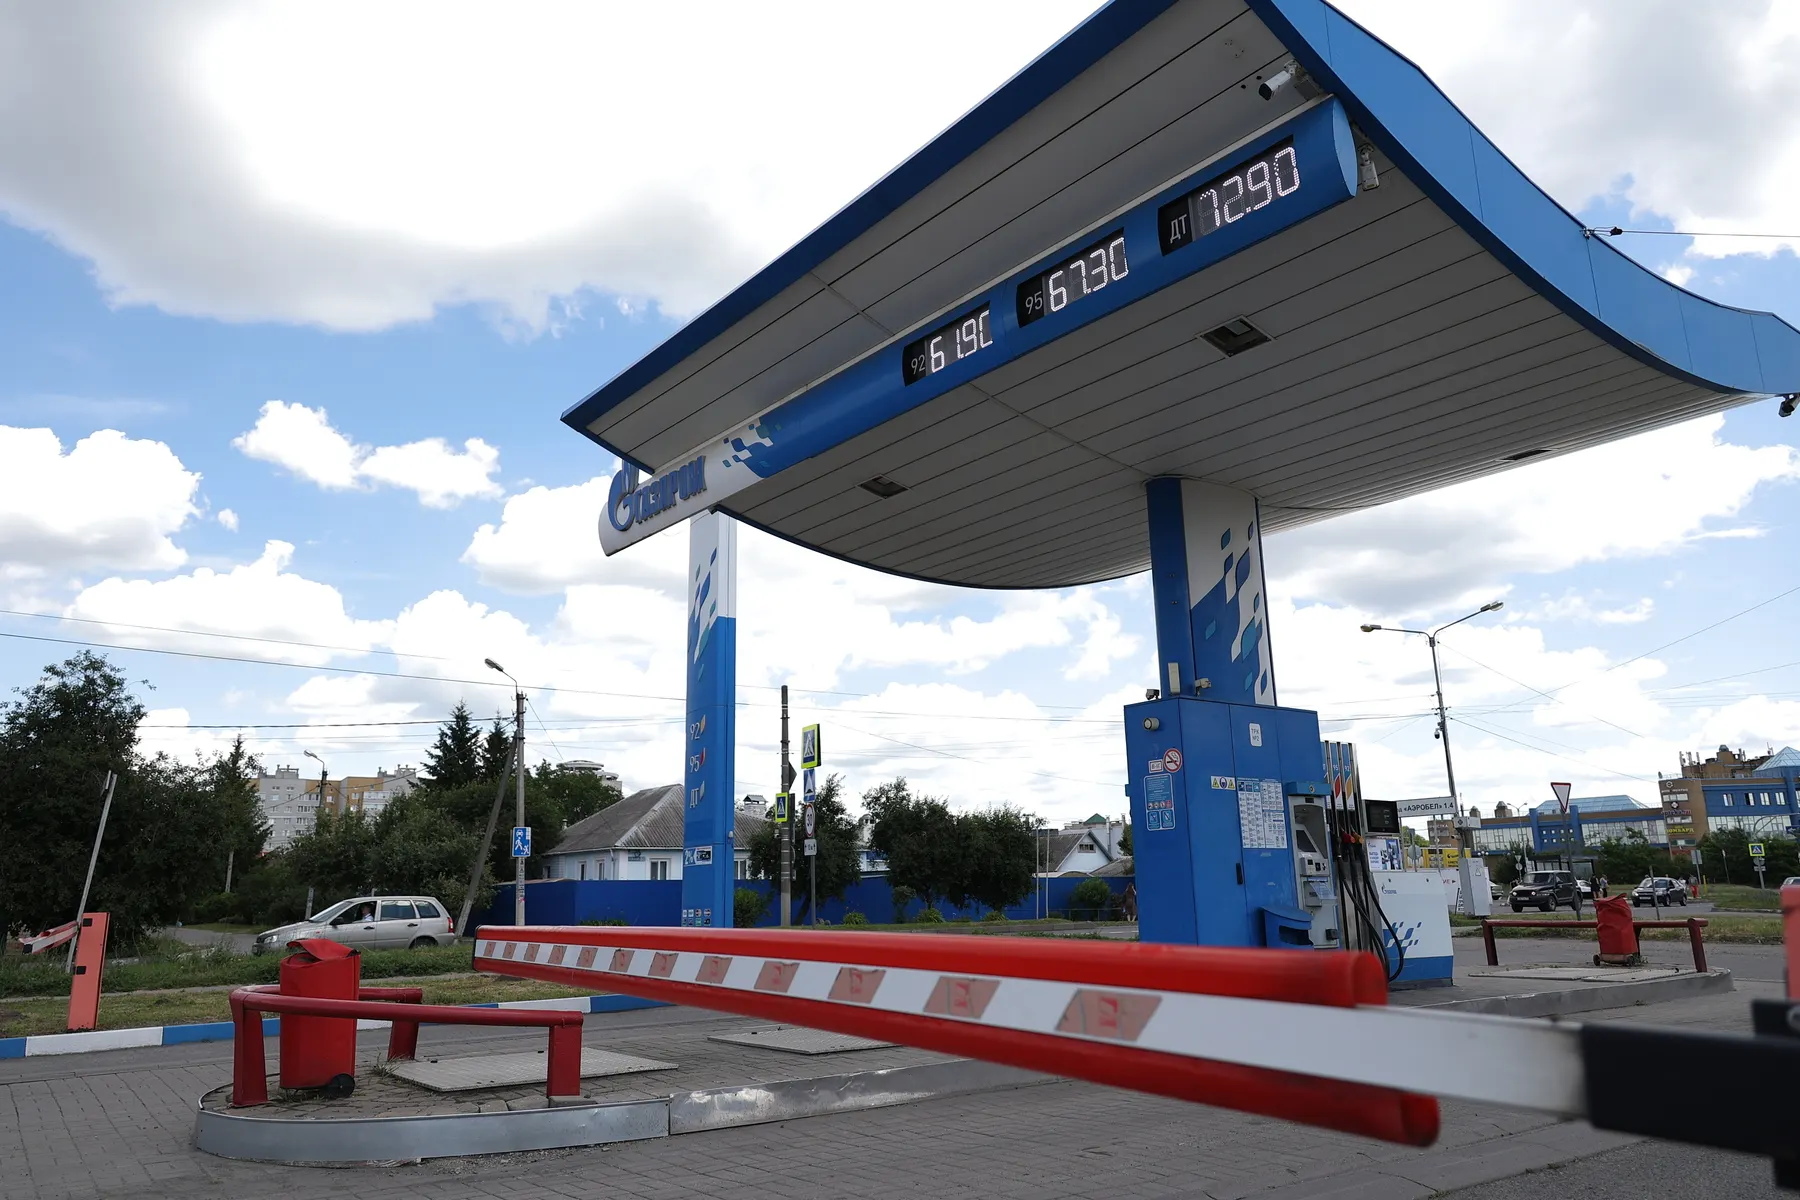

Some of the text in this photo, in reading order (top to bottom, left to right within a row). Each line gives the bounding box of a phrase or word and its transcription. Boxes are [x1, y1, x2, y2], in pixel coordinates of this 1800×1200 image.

[1169, 146, 1300, 244] ДТ 72.90
[1025, 236, 1129, 315] 95 67.30
[911, 354, 926, 375] 92
[689, 721, 701, 741] 92
[689, 753, 700, 773] 95
[689, 786, 699, 809] ДТ
[1403, 803, 1442, 812] «АЭРОБЕЛ»
[807, 813, 813, 827] 30
